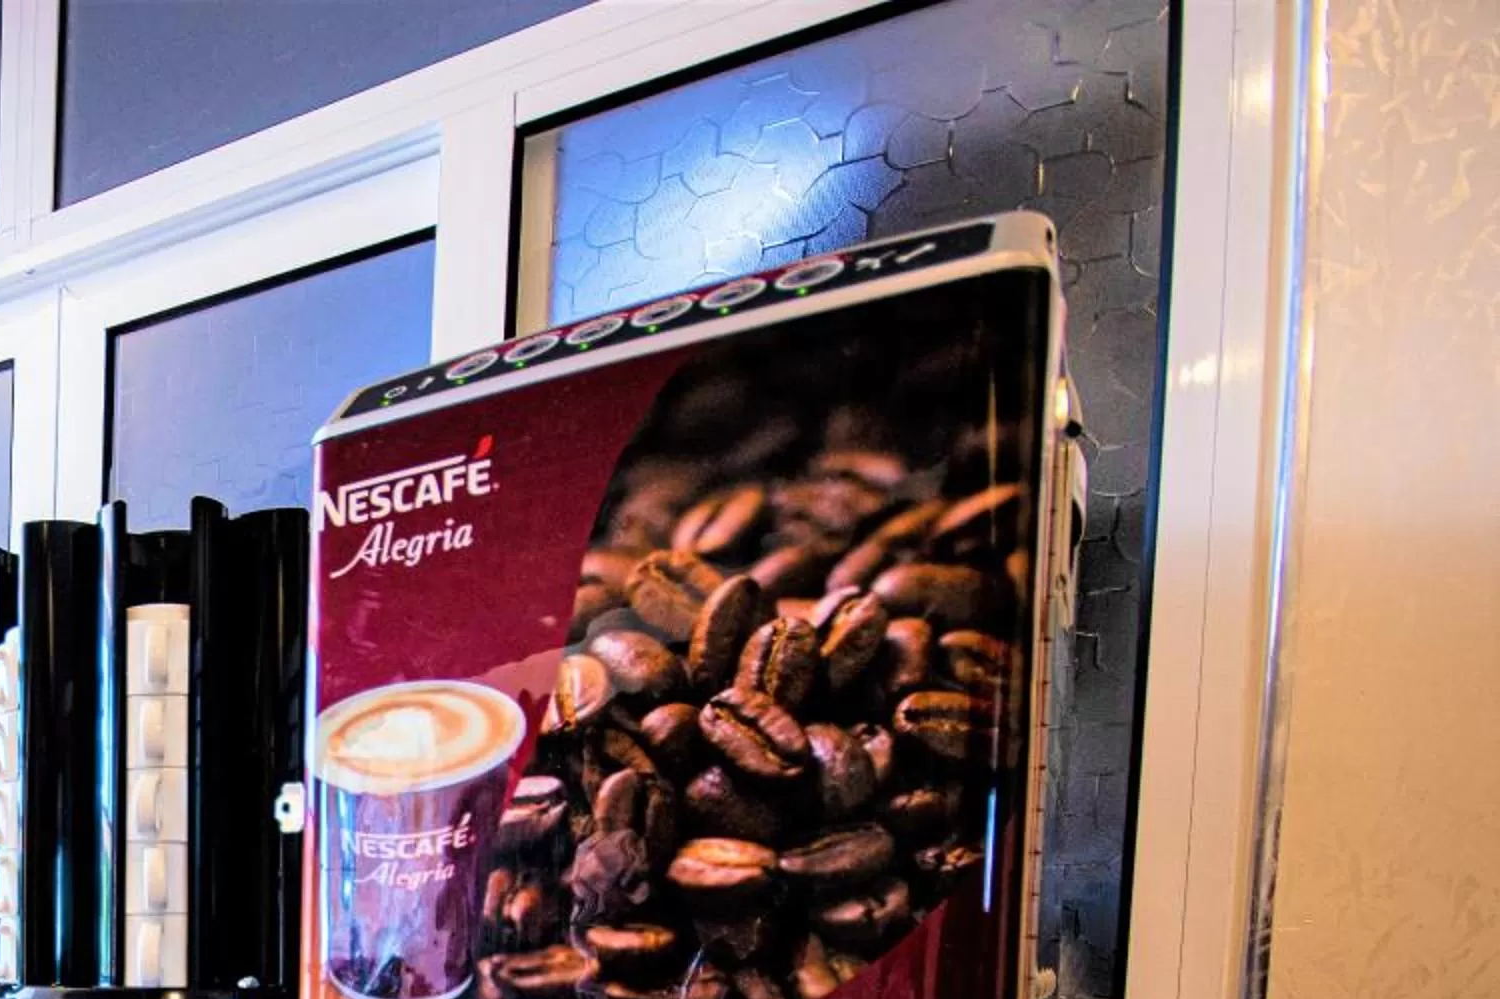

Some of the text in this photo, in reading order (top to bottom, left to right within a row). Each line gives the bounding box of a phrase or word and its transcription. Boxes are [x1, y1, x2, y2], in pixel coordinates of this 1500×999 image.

[314, 434, 493, 532] NESCAFÉ
[329, 518, 474, 579] Alegria
[341, 812, 471, 860] NESCAFÉ
[355, 861, 455, 890] Alegria
